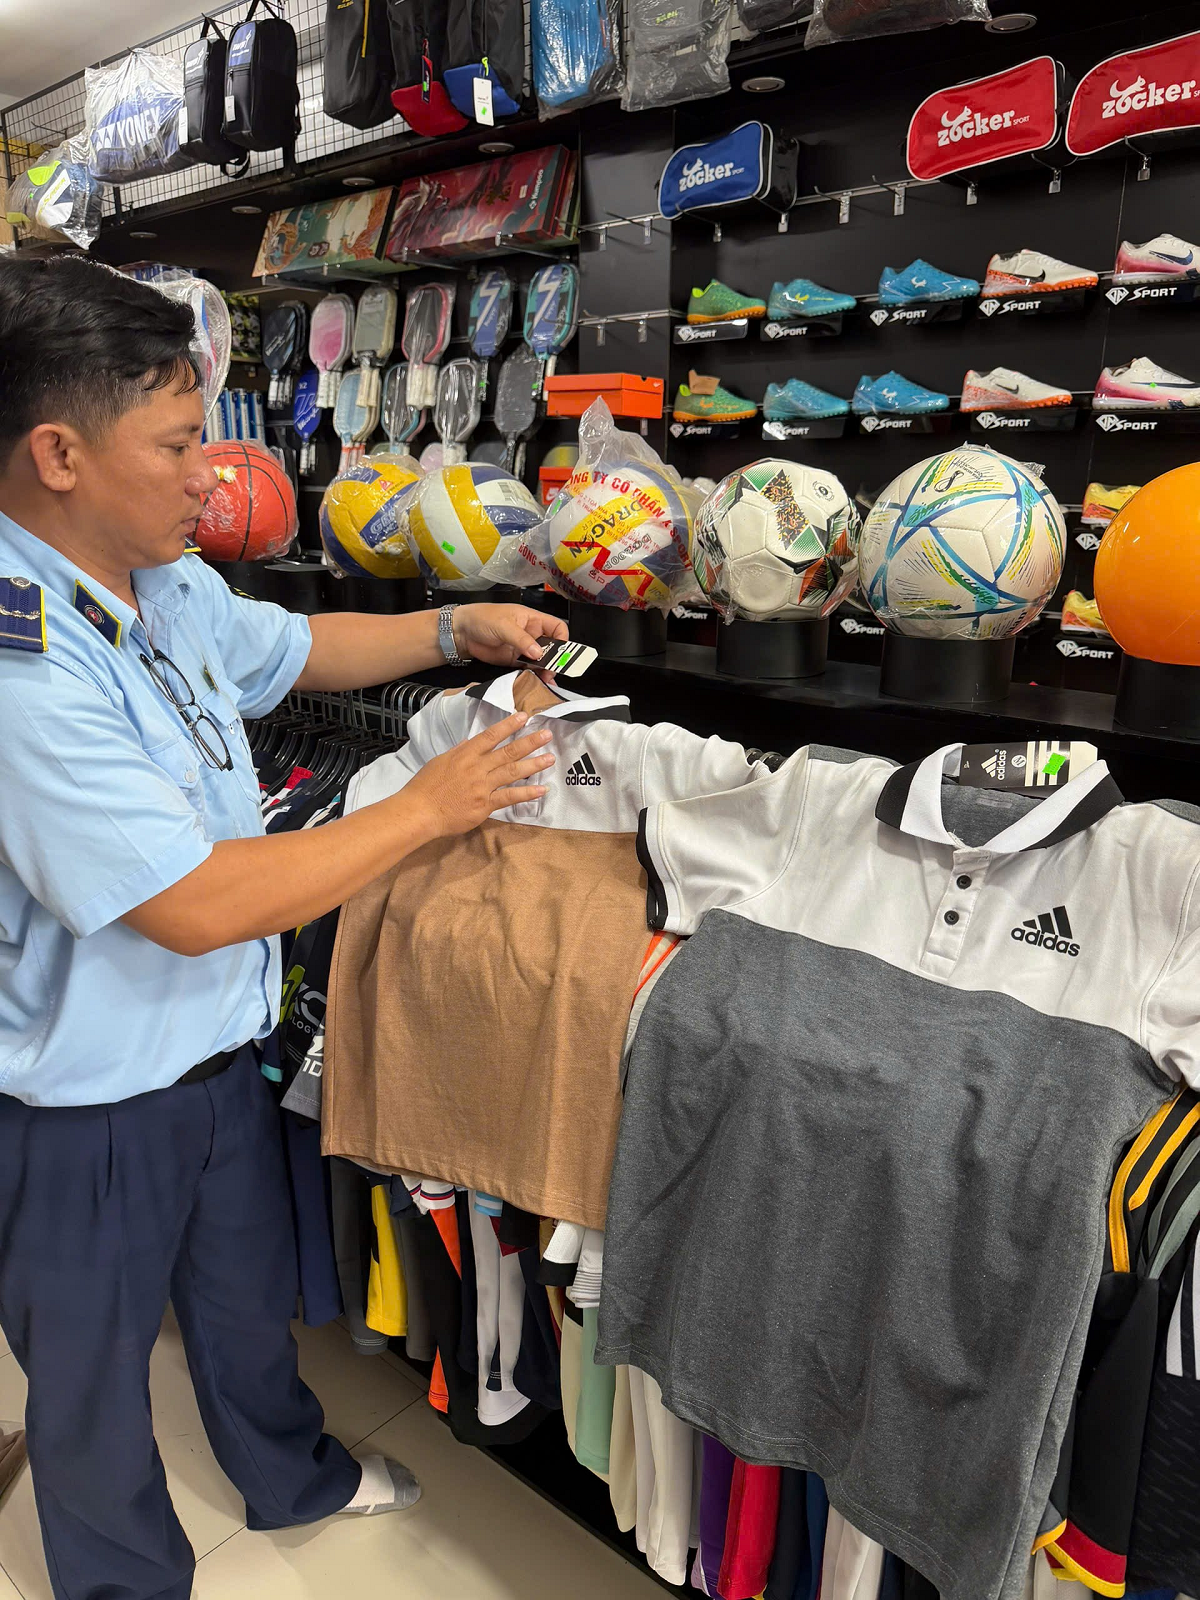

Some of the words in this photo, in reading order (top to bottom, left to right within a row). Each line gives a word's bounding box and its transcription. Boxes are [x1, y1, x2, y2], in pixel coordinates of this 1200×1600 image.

[1102, 79, 1197, 119] zocker
[116, 105, 161, 148] YONEX
[938, 109, 1016, 147] zocker
[1013, 115, 1030, 126] SPORT
[679, 162, 734, 192] zocker
[1127, 286, 1178, 301] SPORT
[997, 300, 1041, 315] SPORT
[888, 308, 928, 323] SPORT
[875, 418, 913, 430] SPORT
[988, 416, 1031, 430] SPORT
[1110, 419, 1158, 432] SPORT
[851, 624, 886, 635] SPORT
[1069, 646, 1115, 659] SPORT
[996, 749, 1007, 780] adidas
[565, 773, 601, 786] adidas
[1011, 925, 1081, 957] adidas
